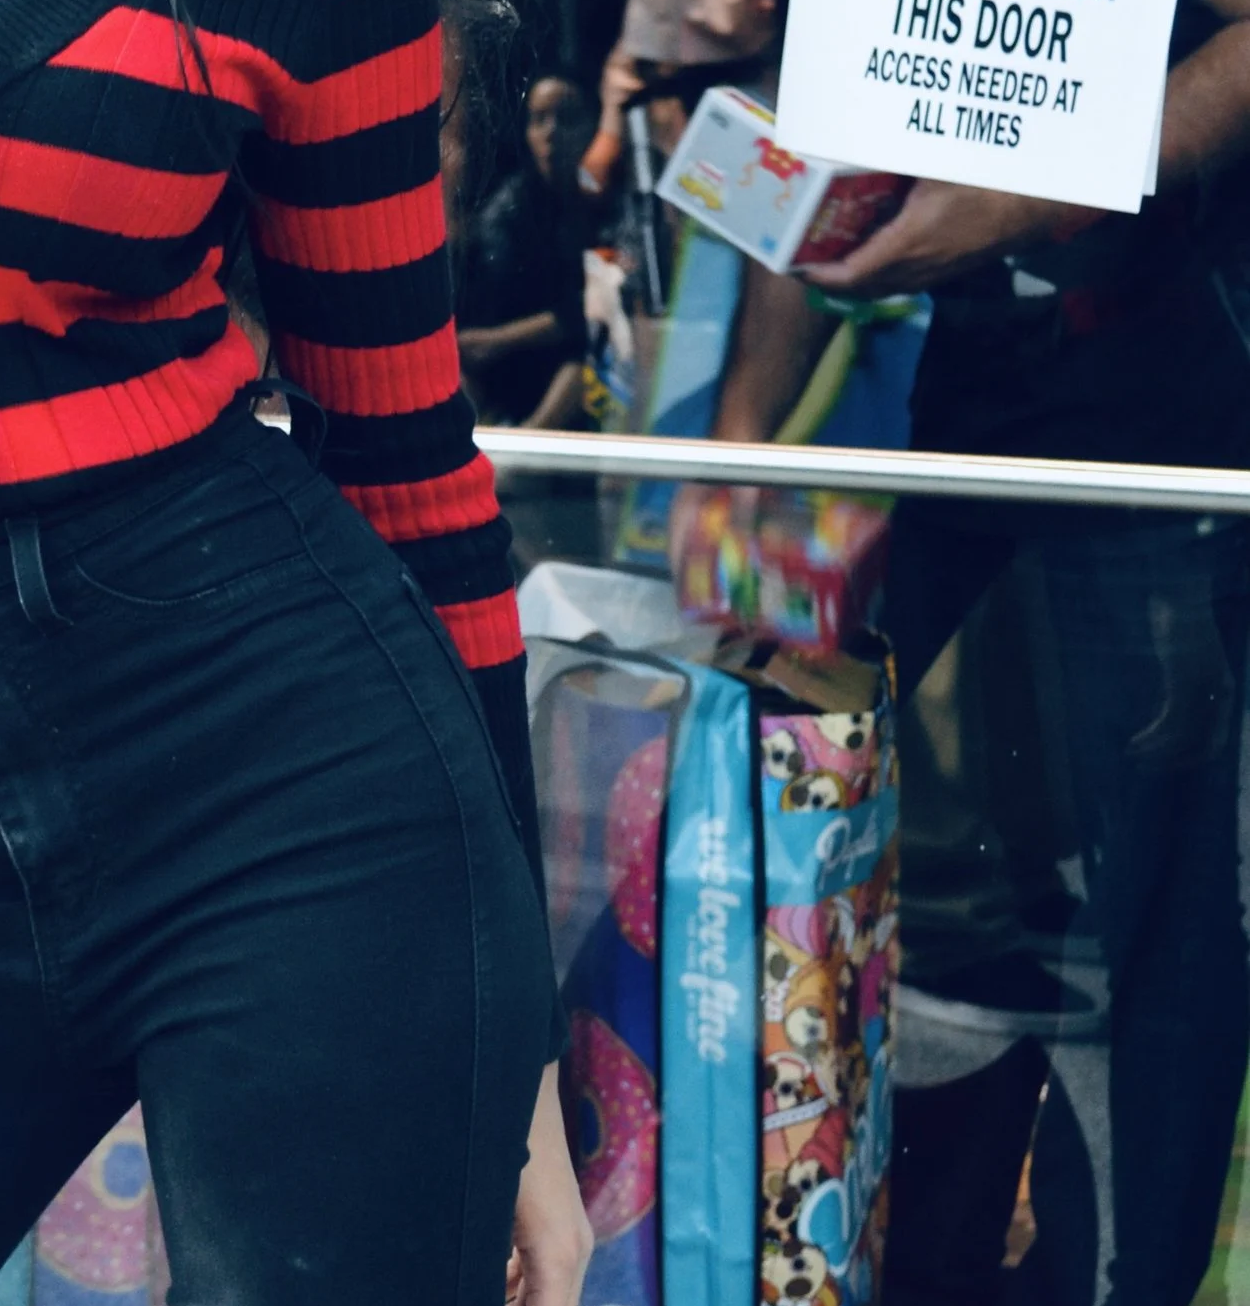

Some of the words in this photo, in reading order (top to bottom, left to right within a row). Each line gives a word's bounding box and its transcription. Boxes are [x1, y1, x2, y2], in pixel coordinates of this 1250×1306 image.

[864, 46, 953, 92] ACCESS
[957, 62, 1048, 108] NEEDED
[1052, 78, 1084, 114] AT
[906, 98, 946, 135] ALL
[954, 105, 1023, 149] TIMES
